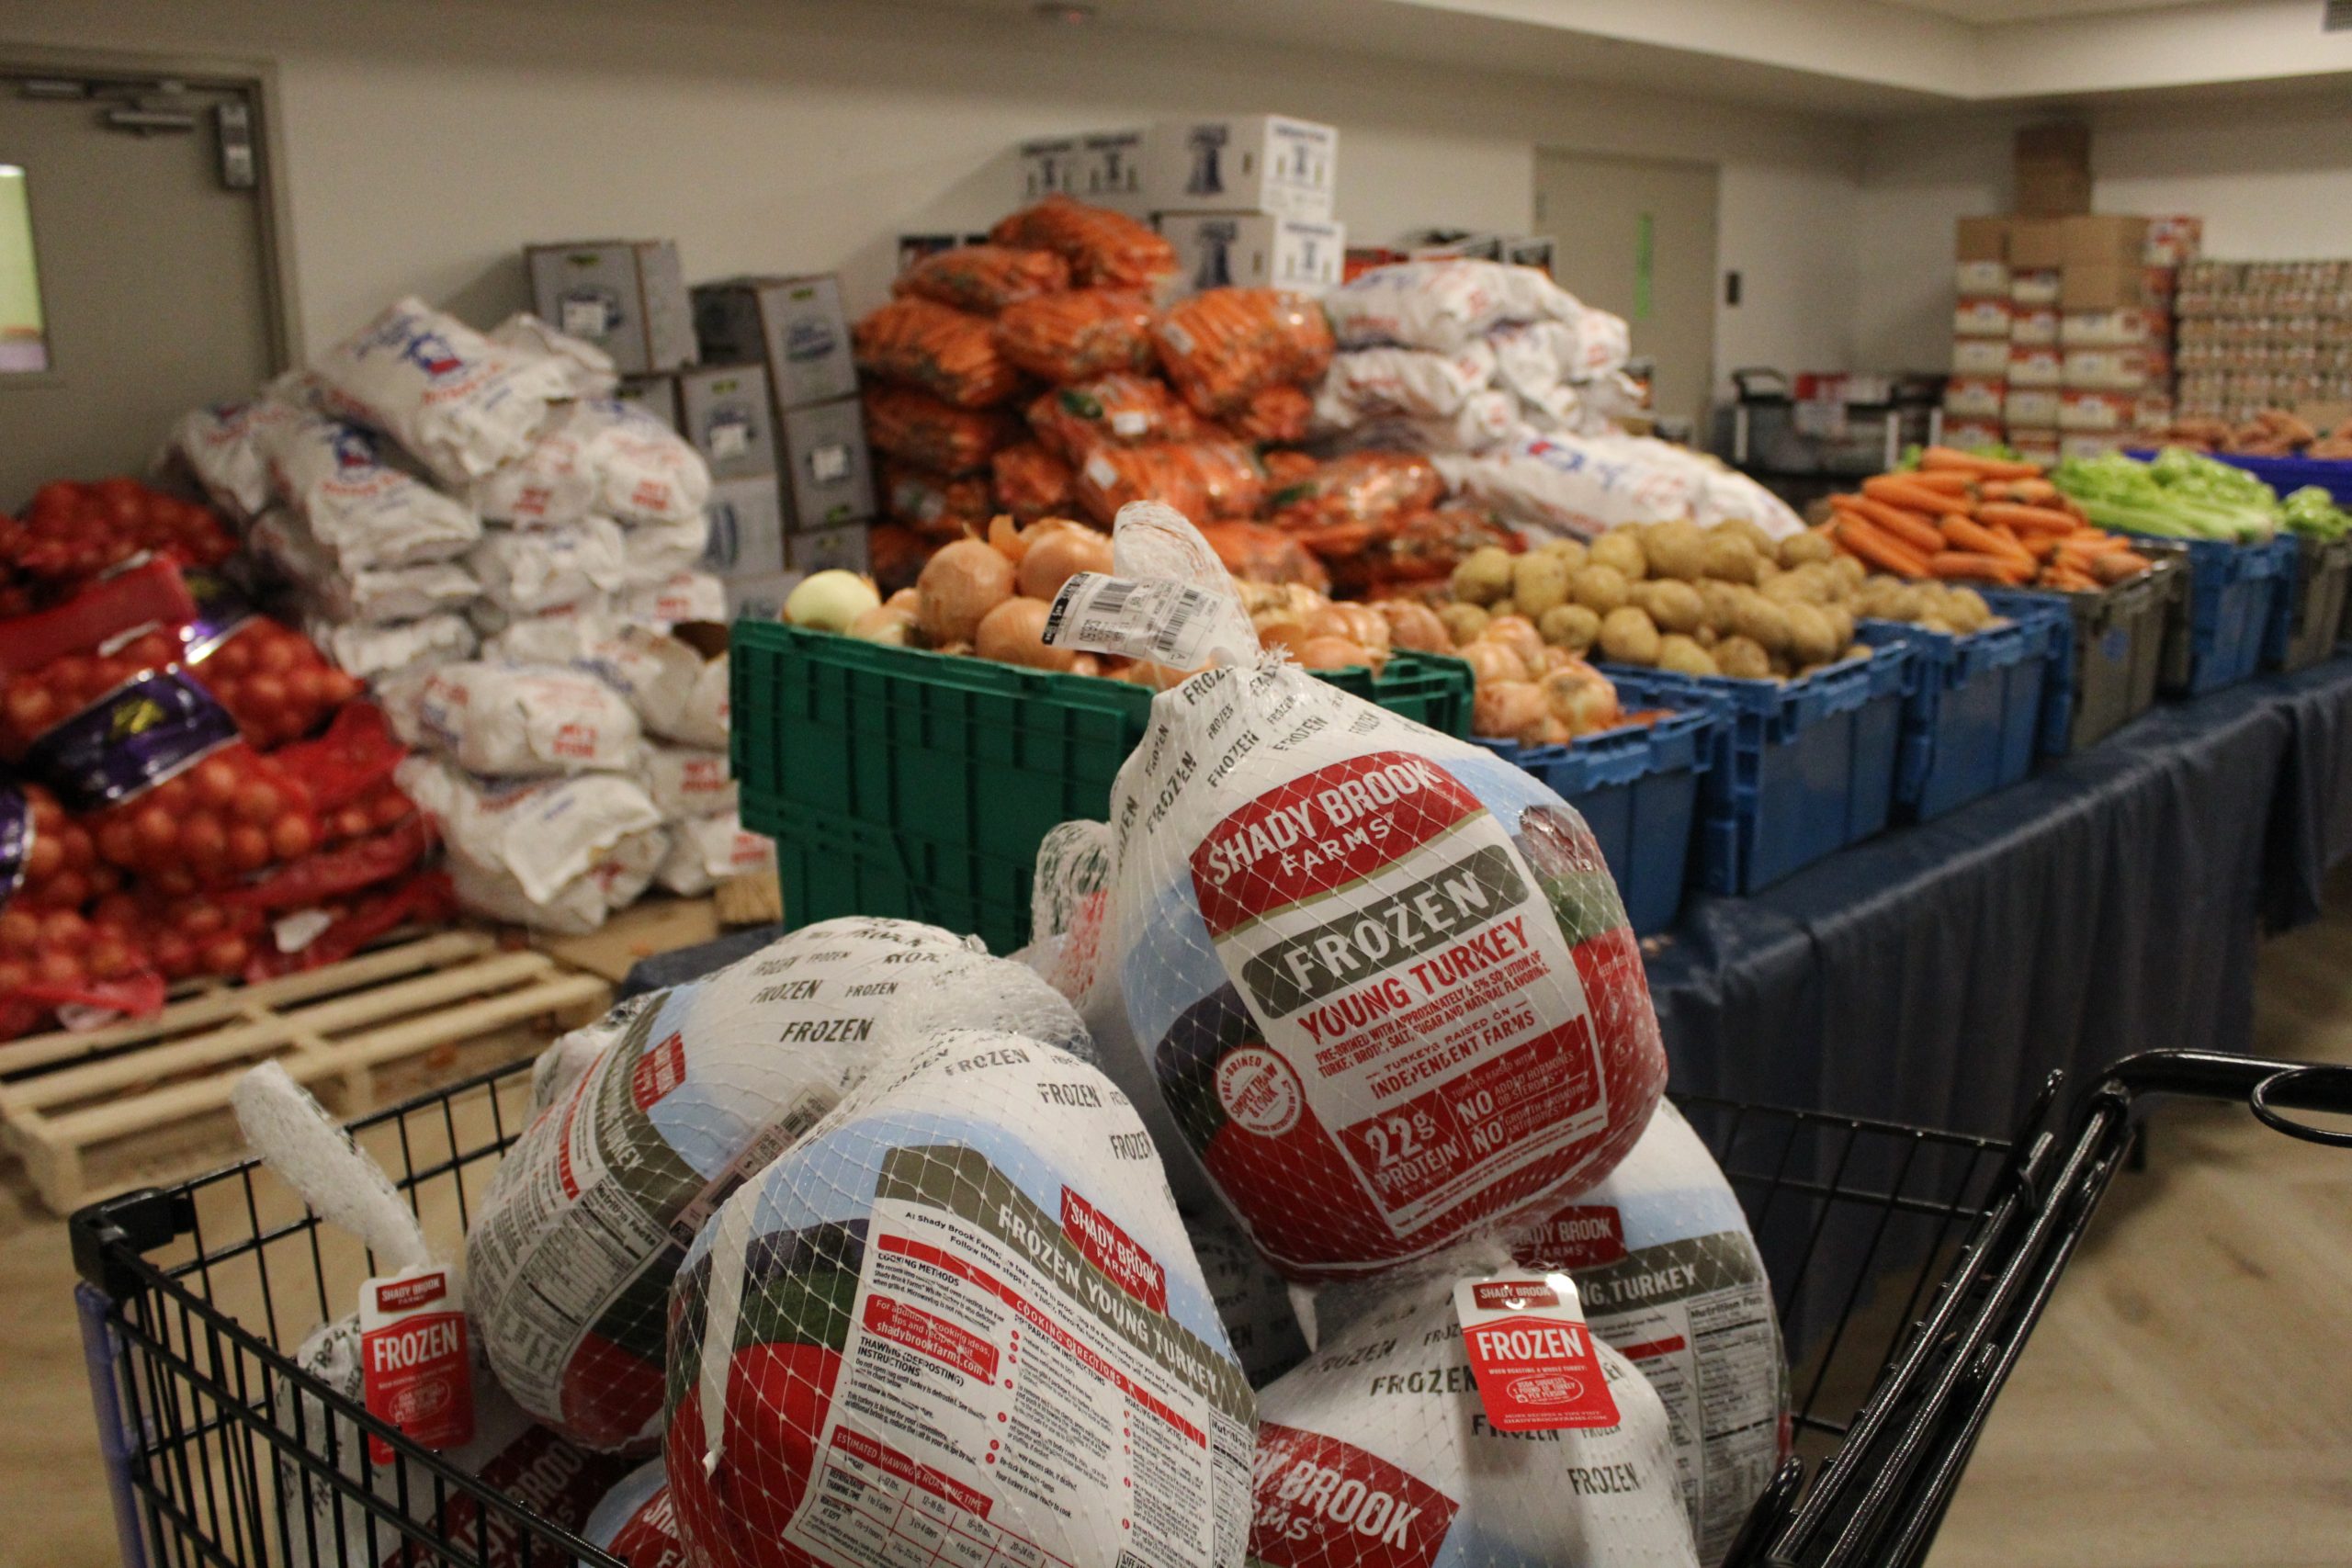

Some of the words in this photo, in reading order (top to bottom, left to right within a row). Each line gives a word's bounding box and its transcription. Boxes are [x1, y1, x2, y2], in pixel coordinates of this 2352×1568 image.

[1207, 729, 1261, 787] FROZEN
[1146, 750, 1197, 835] FROZEN
[1208, 799, 1317, 886] SHADY
[1318, 761, 1443, 827] BROOK
[1283, 873, 1488, 992] FROZEN
[750, 979, 822, 1004] FROZEN
[845, 982, 899, 998] FROZEN
[1297, 977, 1411, 1045] YOUNG
[1408, 915, 1529, 995] TURKEY
[780, 1017, 874, 1043] FROZEN
[1315, 1032, 1369, 1066] PRE-BRINED
[1369, 1021, 1394, 1041] WITH
[1394, 988, 1464, 1032] APPROXIMATELY
[1384, 1043, 1440, 1072] TURKEYS
[1444, 1018, 1488, 1043] RAISED
[1493, 1008, 1510, 1021] ON
[1413, 1013, 1445, 1034] SUGAR
[1444, 1006, 1465, 1021] AND
[944, 1049, 1030, 1077] FROZEN
[1371, 1036, 1479, 1100] INDEPENDENT
[1483, 1010, 1535, 1046] FARMS
[1036, 1083, 1102, 1108] FROZEN
[1456, 1090, 1493, 1125] NO
[1110, 1131, 1153, 1160] FROZEN
[1365, 1111, 1436, 1168] 22g
[1471, 1122, 1503, 1154] NO
[1377, 1141, 1460, 1193] PROTEIN
[1070, 1202, 1114, 1254] SHADY
[1117, 1241, 1159, 1291] BROOK
[1559, 1218, 1611, 1240] BROOK
[878, 1253, 917, 1269] COOKING
[918, 1262, 960, 1287] METHODS
[918, 1215, 945, 1229] Shady
[948, 1224, 974, 1241] Brook
[1014, 1264, 1029, 1280] take
[1031, 1277, 1047, 1296] pride
[950, 1235, 978, 1255] Follow
[981, 1251, 1001, 1268] these
[1003, 1263, 1022, 1283] steps
[381, 1288, 412, 1302] SHADY
[999, 1203, 1080, 1288] FROZEN
[1086, 1277, 1148, 1343] YOUNG
[1153, 1327, 1216, 1396] TURKEY
[1480, 1286, 1513, 1299] SHADY
[1516, 1286, 1551, 1297] BROOK
[1610, 1264, 1697, 1303] TURKEY
[876, 1298, 890, 1312] For
[933, 1321, 967, 1343] cooking
[967, 1337, 991, 1357] ideas,
[890, 1313, 907, 1327] tips
[908, 1319, 924, 1334] and
[1016, 1300, 1064, 1345] COOKING
[1066, 1337, 1121, 1386] DIRECTIONS
[1424, 1324, 1463, 1347] FROZ
[1476, 1328, 1585, 1361] FROZEN
[373, 1319, 458, 1372] FROZEN
[858, 1347, 920, 1376] INSTRUCTIONS
[875, 1315, 984, 1379] shadybrookfarms.com
[1370, 1369, 1478, 1397] FROZEN
[837, 1433, 877, 1460] ESTIMATED
[965, 1494, 983, 1512] TIME
[1006, 1475, 1023, 1493] turkey
[1566, 1462, 1641, 1495] FROZEN
[1276, 1461, 1421, 1551] BROOK
